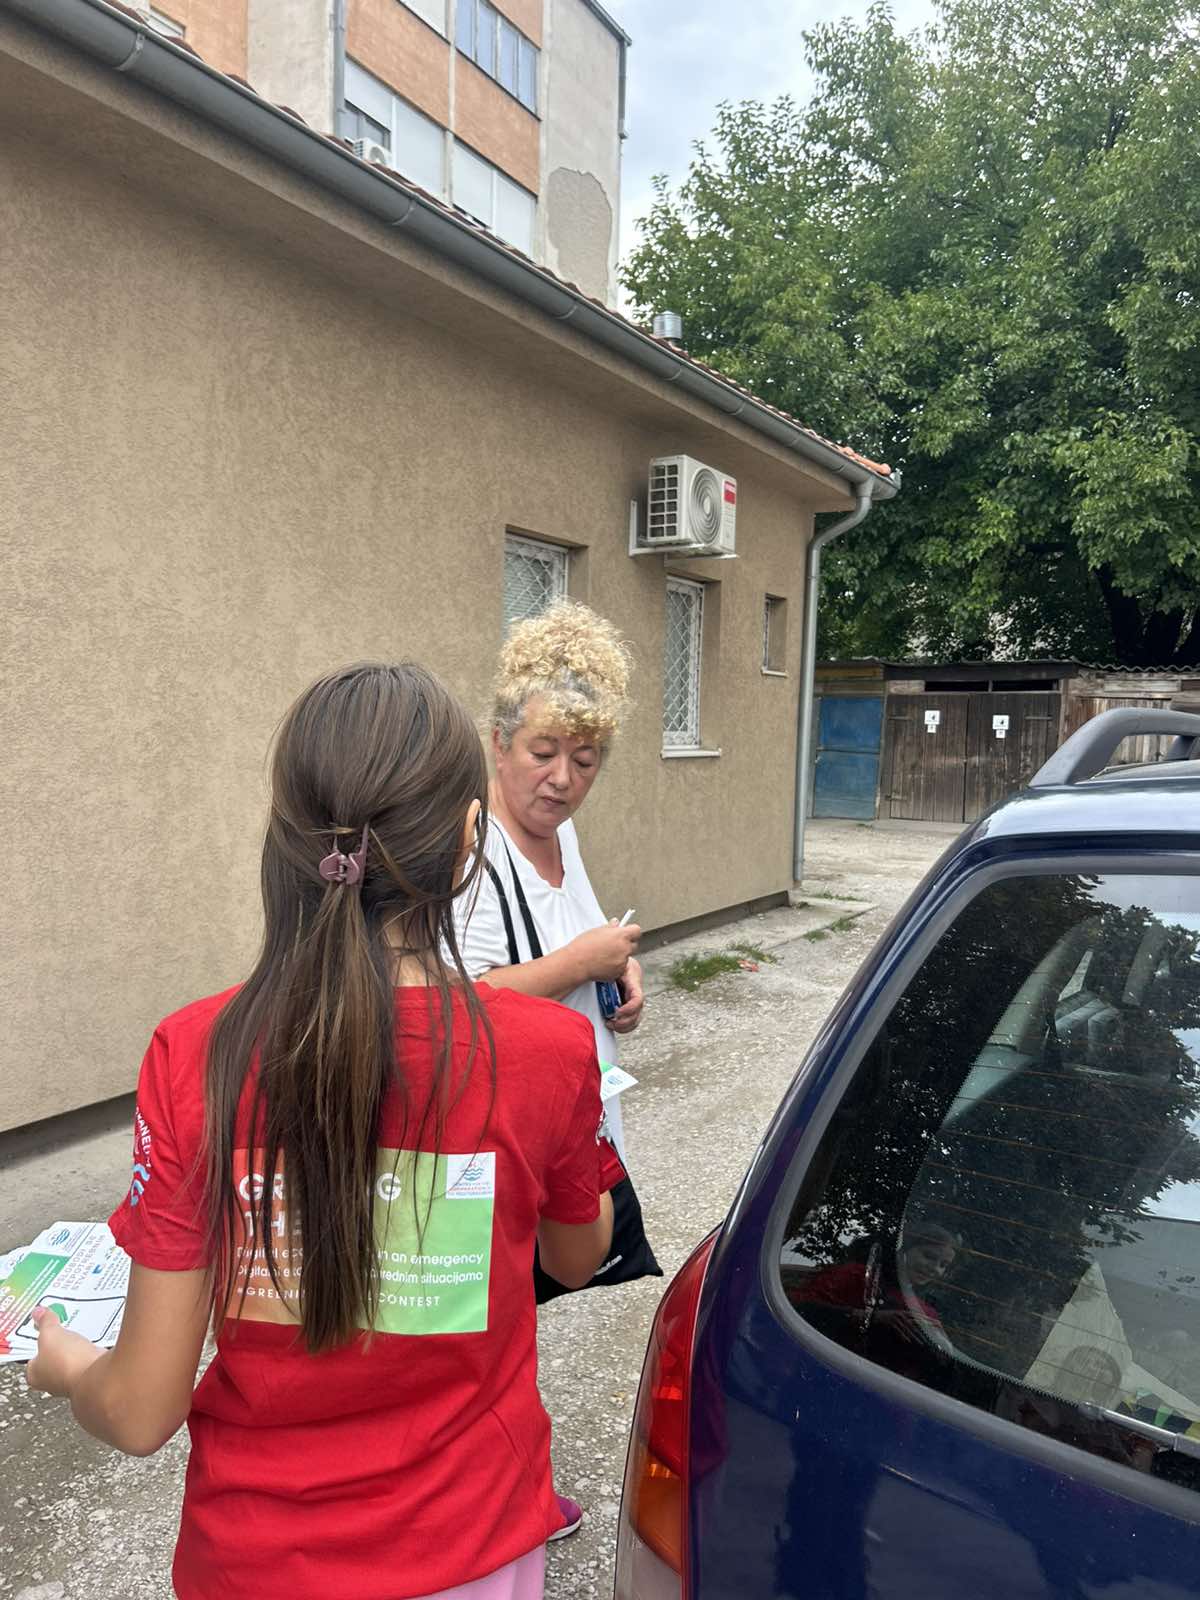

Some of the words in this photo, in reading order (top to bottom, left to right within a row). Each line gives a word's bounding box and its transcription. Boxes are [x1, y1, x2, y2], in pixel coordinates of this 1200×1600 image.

[391, 1252, 408, 1264] an
[410, 1251, 484, 1268] emergency
[421, 1269, 484, 1285] situacijama
